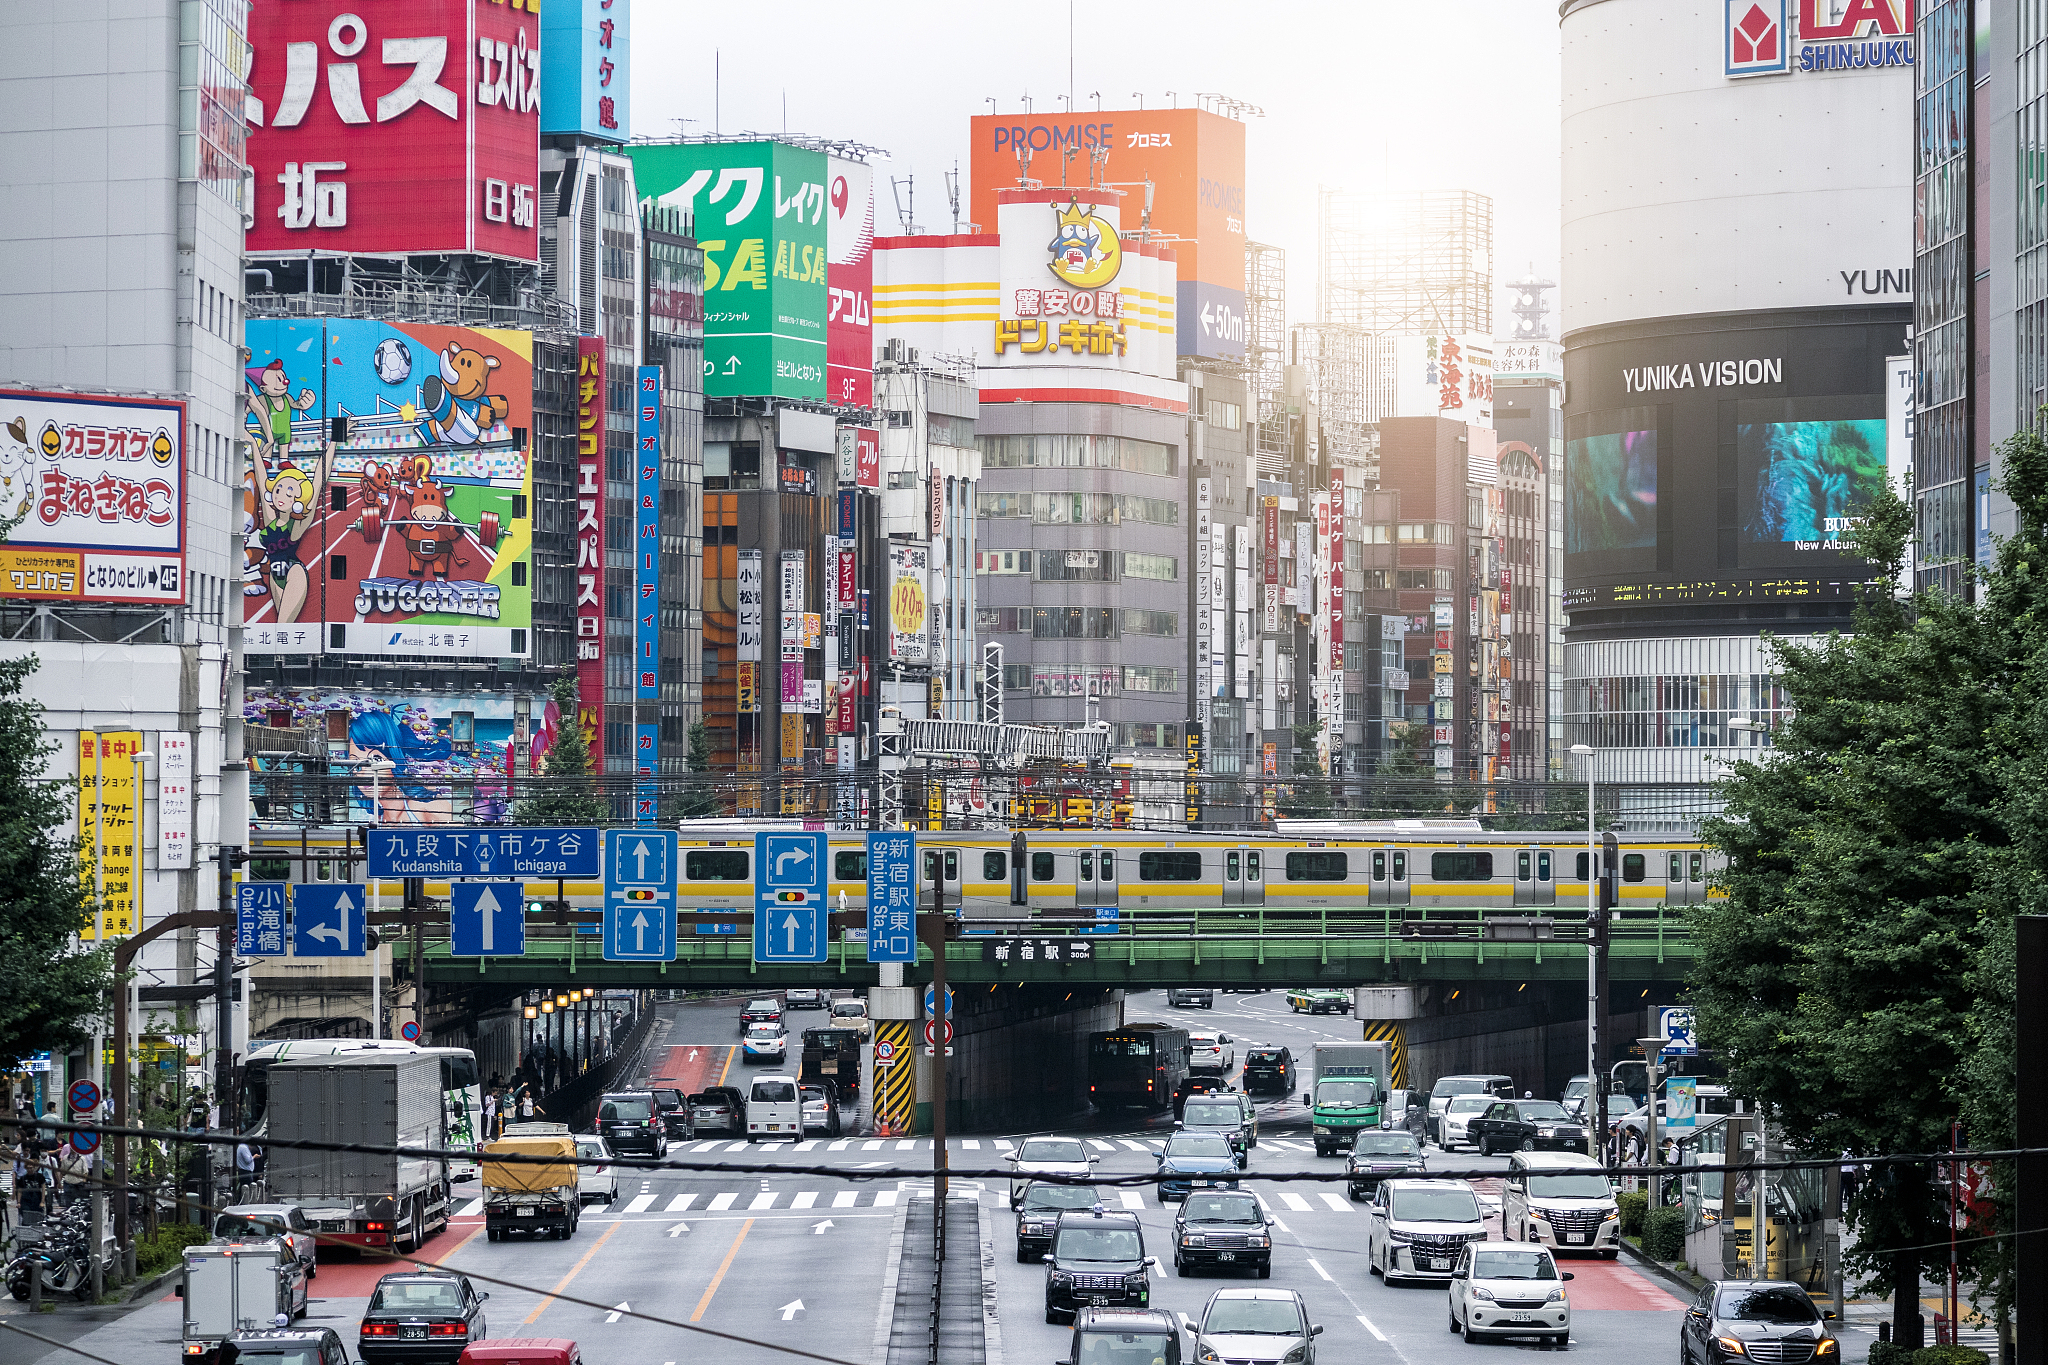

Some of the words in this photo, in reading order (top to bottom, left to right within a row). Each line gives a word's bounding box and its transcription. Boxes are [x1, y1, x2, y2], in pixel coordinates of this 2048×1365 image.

[993, 123, 1114, 152] PROMISE
[1126, 131, 1173, 149] プロミス
[485, 177, 534, 228] 日拓
[640, 167, 764, 226] イク
[775, 175, 824, 226] レイク
[1200, 176, 1242, 216] PROMISE
[1226, 215, 1242, 235] プロミス
[773, 239, 825, 286] ALSA
[1840, 268, 1914, 296] YUNI
[828, 286, 869, 327] アコム
[1015, 289, 1125, 319] 驚安の殿堂
[1215, 302, 1243, 344] 50m
[1504, 344, 1540, 358] 水の森
[776, 359, 815, 381] 当ビルとなり
[1437, 335, 1464, 409] 東海苑
[1622, 363, 1695, 394] YUNIKA
[1700, 357, 1783, 388] VISION
[842, 377, 856, 400] 3F
[579, 351, 599, 455] パチンコ
[64, 426, 149, 459] カラオケ
[842, 433, 852, 477] 戸谷ビル
[858, 440, 878, 465] フル
[39, 465, 173, 525] まねきねこ
[1266, 497, 1277, 506] 8F
[1331, 478, 1343, 542] カラオケ
[578, 463, 599, 608] エスパス
[1795, 540, 1820, 551] New
[1823, 539, 1861, 551] Album
[16, 556, 76, 569] ひとりカラオケ専門店
[9, 570, 76, 592] ワンカラ
[87, 564, 147, 589] となりのビル
[162, 565, 178, 591] 4F
[842, 564, 852, 600] アイフル
[1331, 561, 1343, 622] パセラ
[355, 577, 500, 619] JUGGLER
[740, 568, 753, 646] 小松ビル
[896, 584, 923, 619] 190円
[259, 631, 306, 645] 北電子
[402, 638, 424, 647] 株式会社
[428, 633, 469, 647] 北電子
[577, 617, 600, 661] 日拓
[842, 697, 851, 723] アコム
[1332, 674, 1342, 721] パーティー
[82, 739, 127, 759] 営業中
[164, 740, 185, 749] 営業中
[167, 753, 182, 761] メガネ
[164, 786, 185, 794] 営業中
[165, 799, 184, 807] チケット
[164, 831, 186, 840] 営業中
[167, 843, 183, 851] 牛かつ
[385, 834, 470, 858] 九段下
[167, 852, 183, 861] もと村
[392, 859, 463, 873] Kudanshita
[514, 858, 567, 874] Ichigaya
[479, 847, 489, 860] 4
[91, 865, 130, 876] Echange
[873, 841, 887, 900] Shinjuku
[241, 887, 254, 919] Otaki
[888, 837, 910, 955] 新宿駅東口
[257, 887, 281, 951] 小滝橋
[241, 921, 254, 952] Brdg.
[995, 945, 1060, 960] 新宿駅
[1070, 951, 1090, 959] 300M
